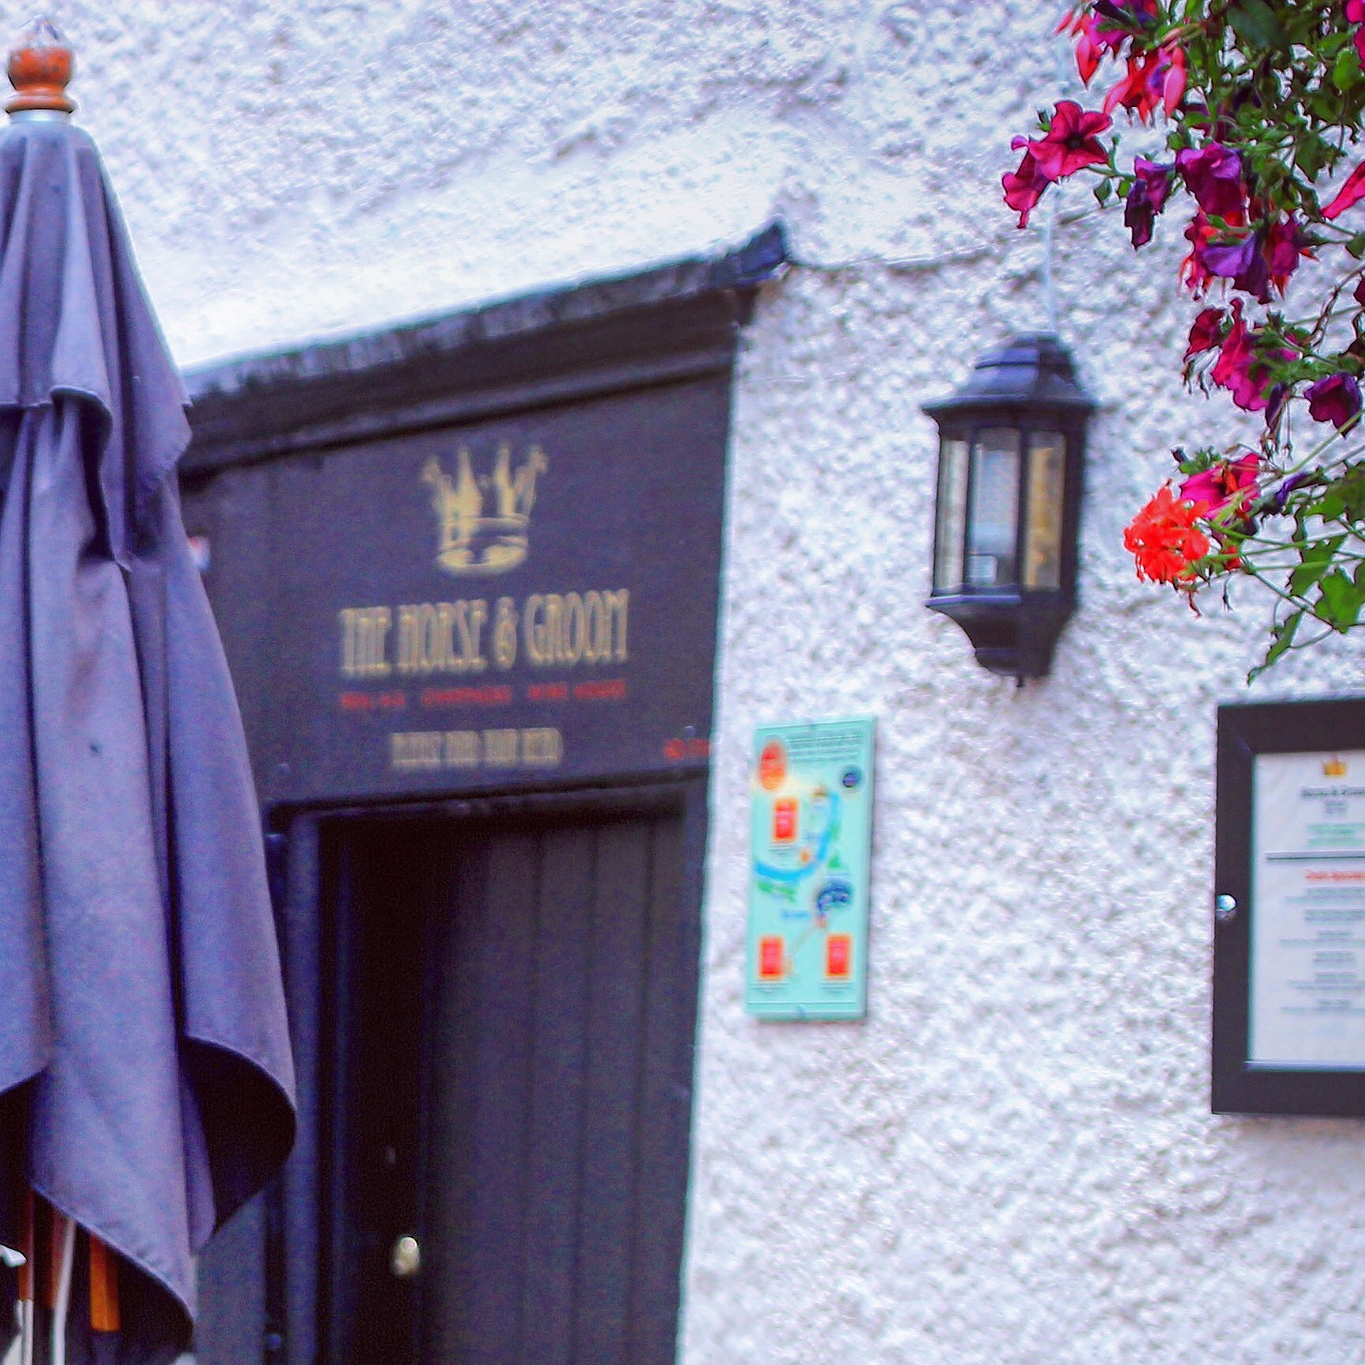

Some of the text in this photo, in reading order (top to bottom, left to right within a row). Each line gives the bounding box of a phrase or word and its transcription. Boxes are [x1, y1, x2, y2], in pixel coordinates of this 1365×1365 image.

[397, 598, 488, 674] HORSE
[494, 596, 518, 669] &
[524, 588, 630, 666] GROOM
